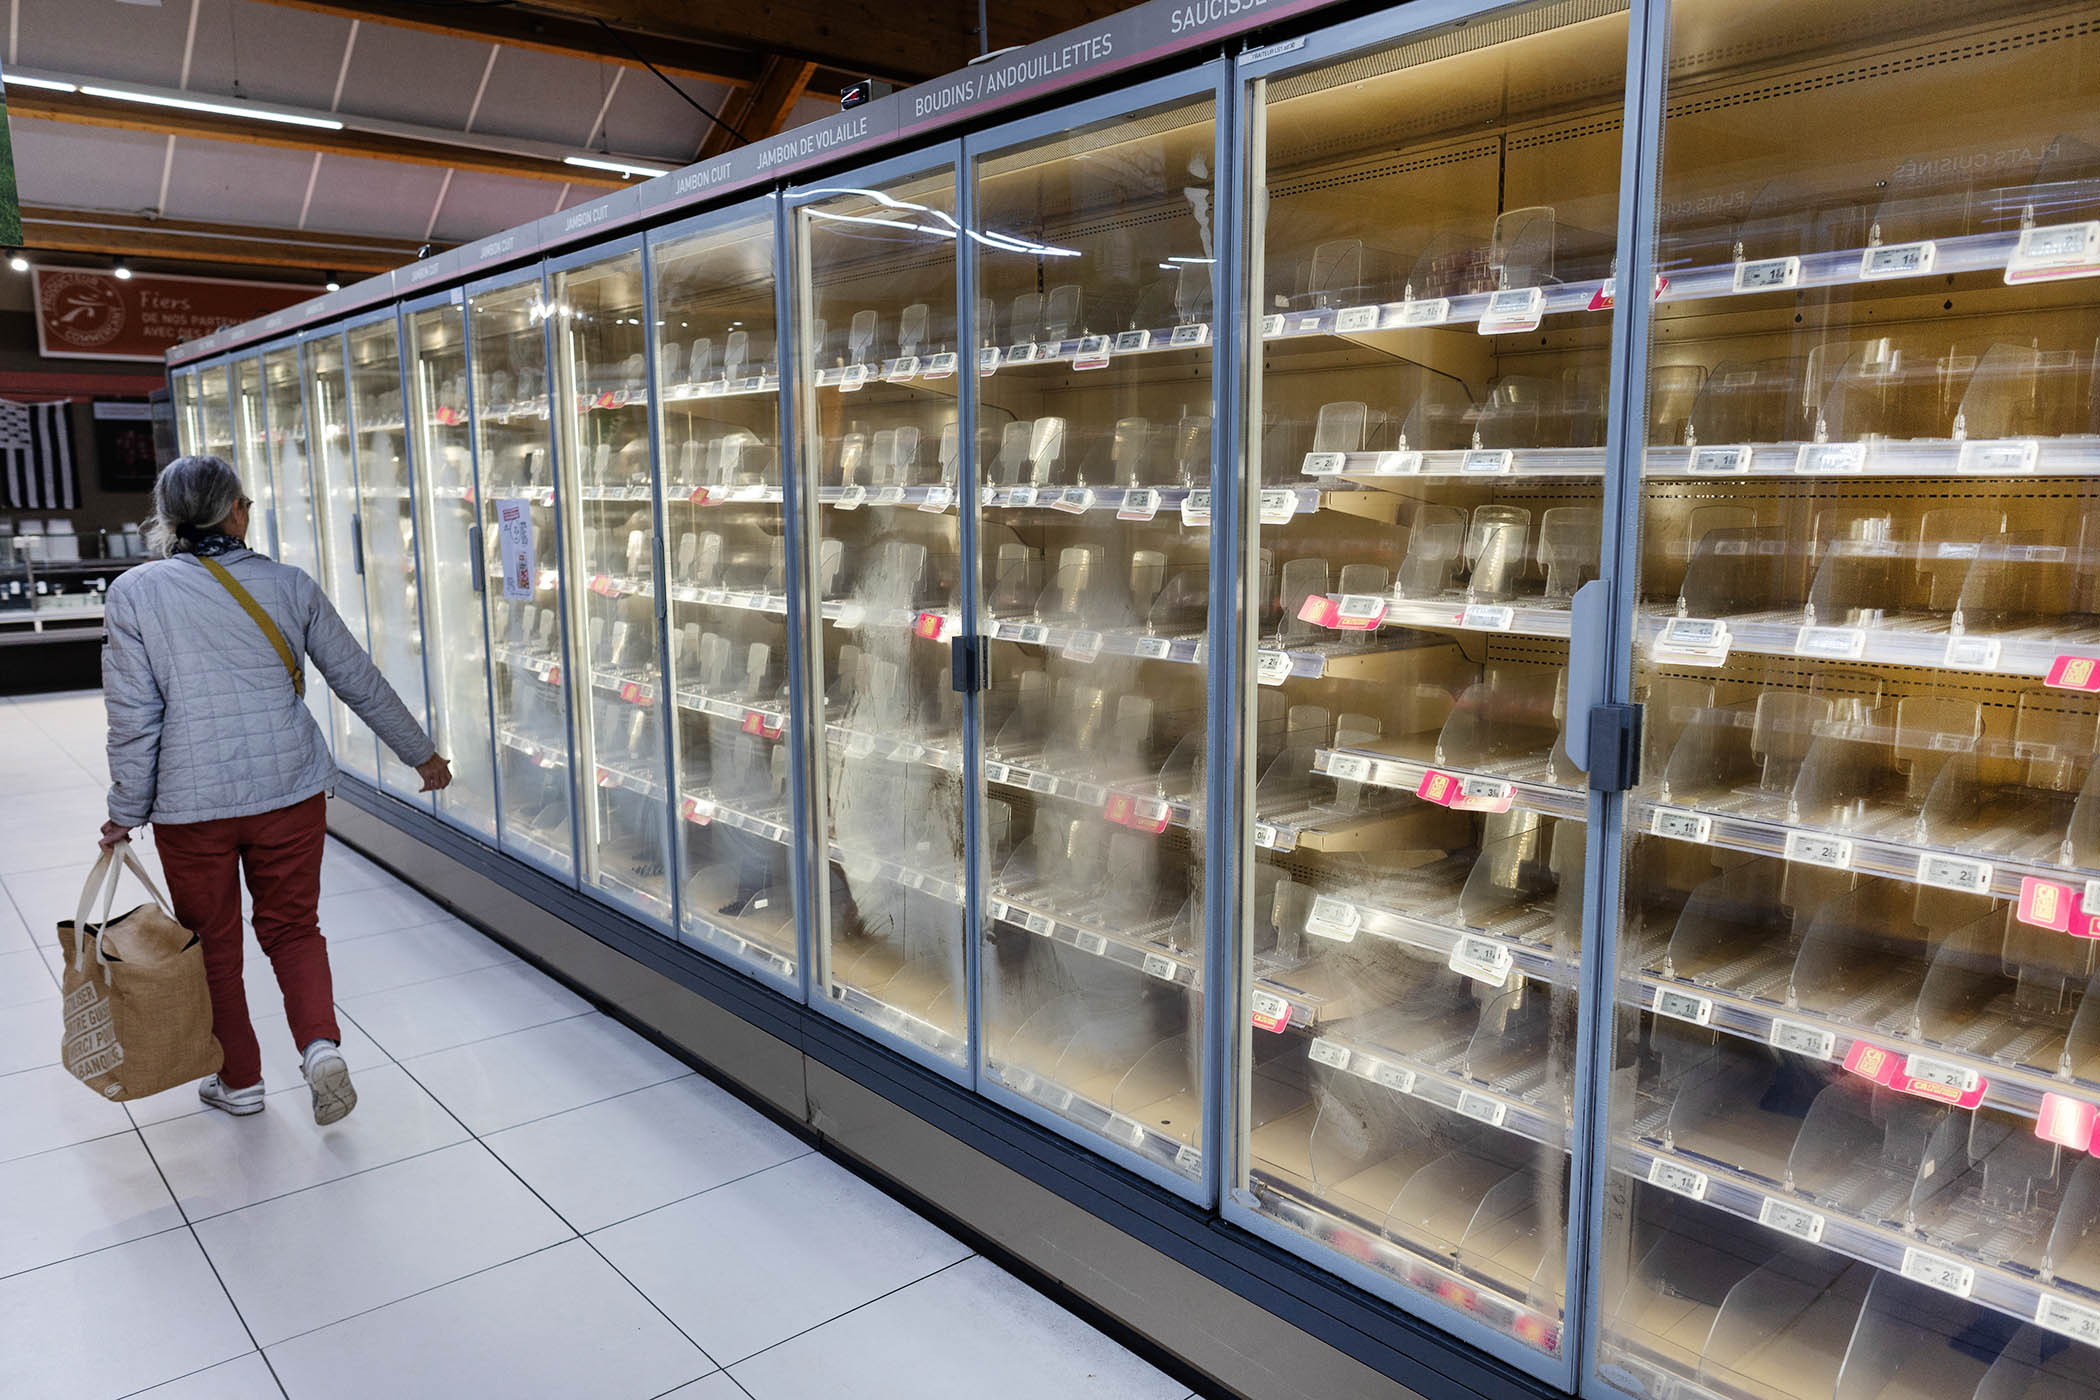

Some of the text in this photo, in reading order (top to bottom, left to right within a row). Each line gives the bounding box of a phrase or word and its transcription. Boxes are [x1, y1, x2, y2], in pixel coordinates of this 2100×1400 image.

[1171, 0, 1267, 33] SAUCIS
[915, 33, 1113, 118] BOUDINS / ANDOUILLETTES
[756, 116, 868, 171] JAMBON DE VOLAILLE
[675, 162, 732, 195] JAMBON CUIT
[565, 204, 609, 231] JAMBON CUIT
[139, 290, 191, 311] Fiers
